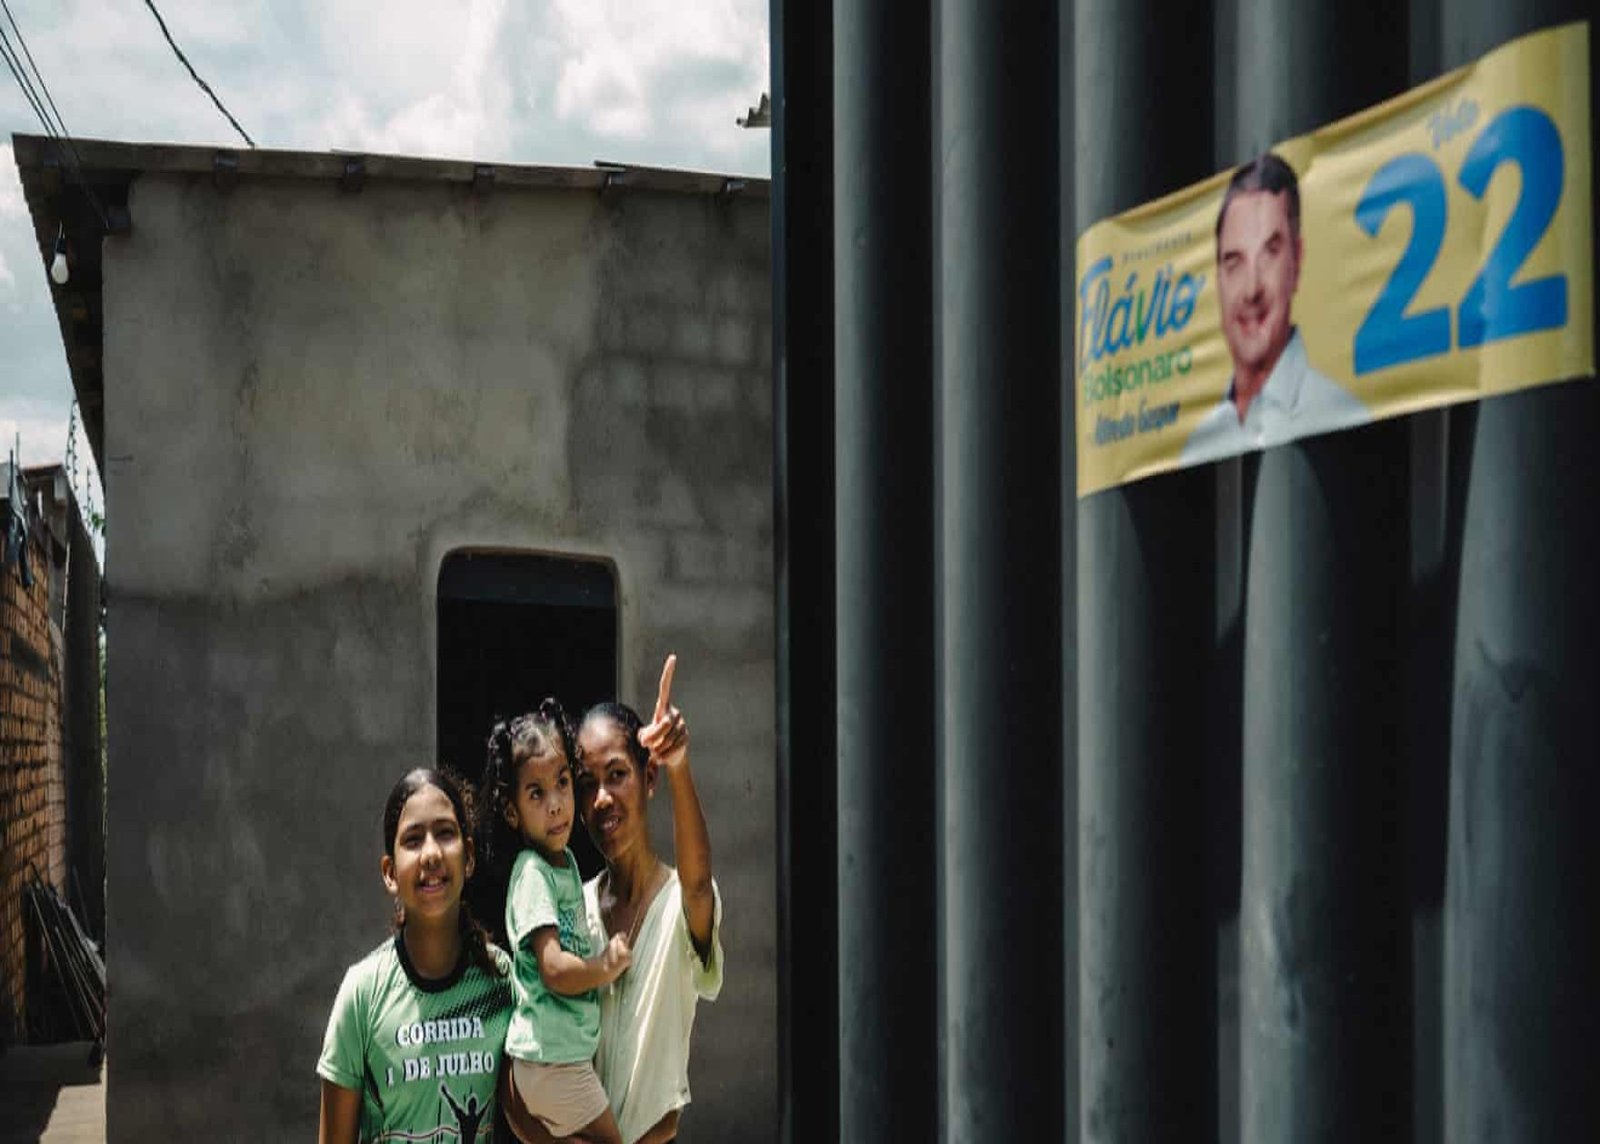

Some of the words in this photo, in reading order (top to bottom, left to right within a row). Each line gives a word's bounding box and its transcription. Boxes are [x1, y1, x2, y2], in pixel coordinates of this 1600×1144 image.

[1353, 104, 1568, 377] 22
[1078, 256, 1206, 378] Flávio
[1083, 345, 1193, 404] Bolsonaro
[396, 1017, 485, 1046] CORRIDA
[403, 1055, 431, 1082] DE
[436, 1050, 495, 1077] JULHO
